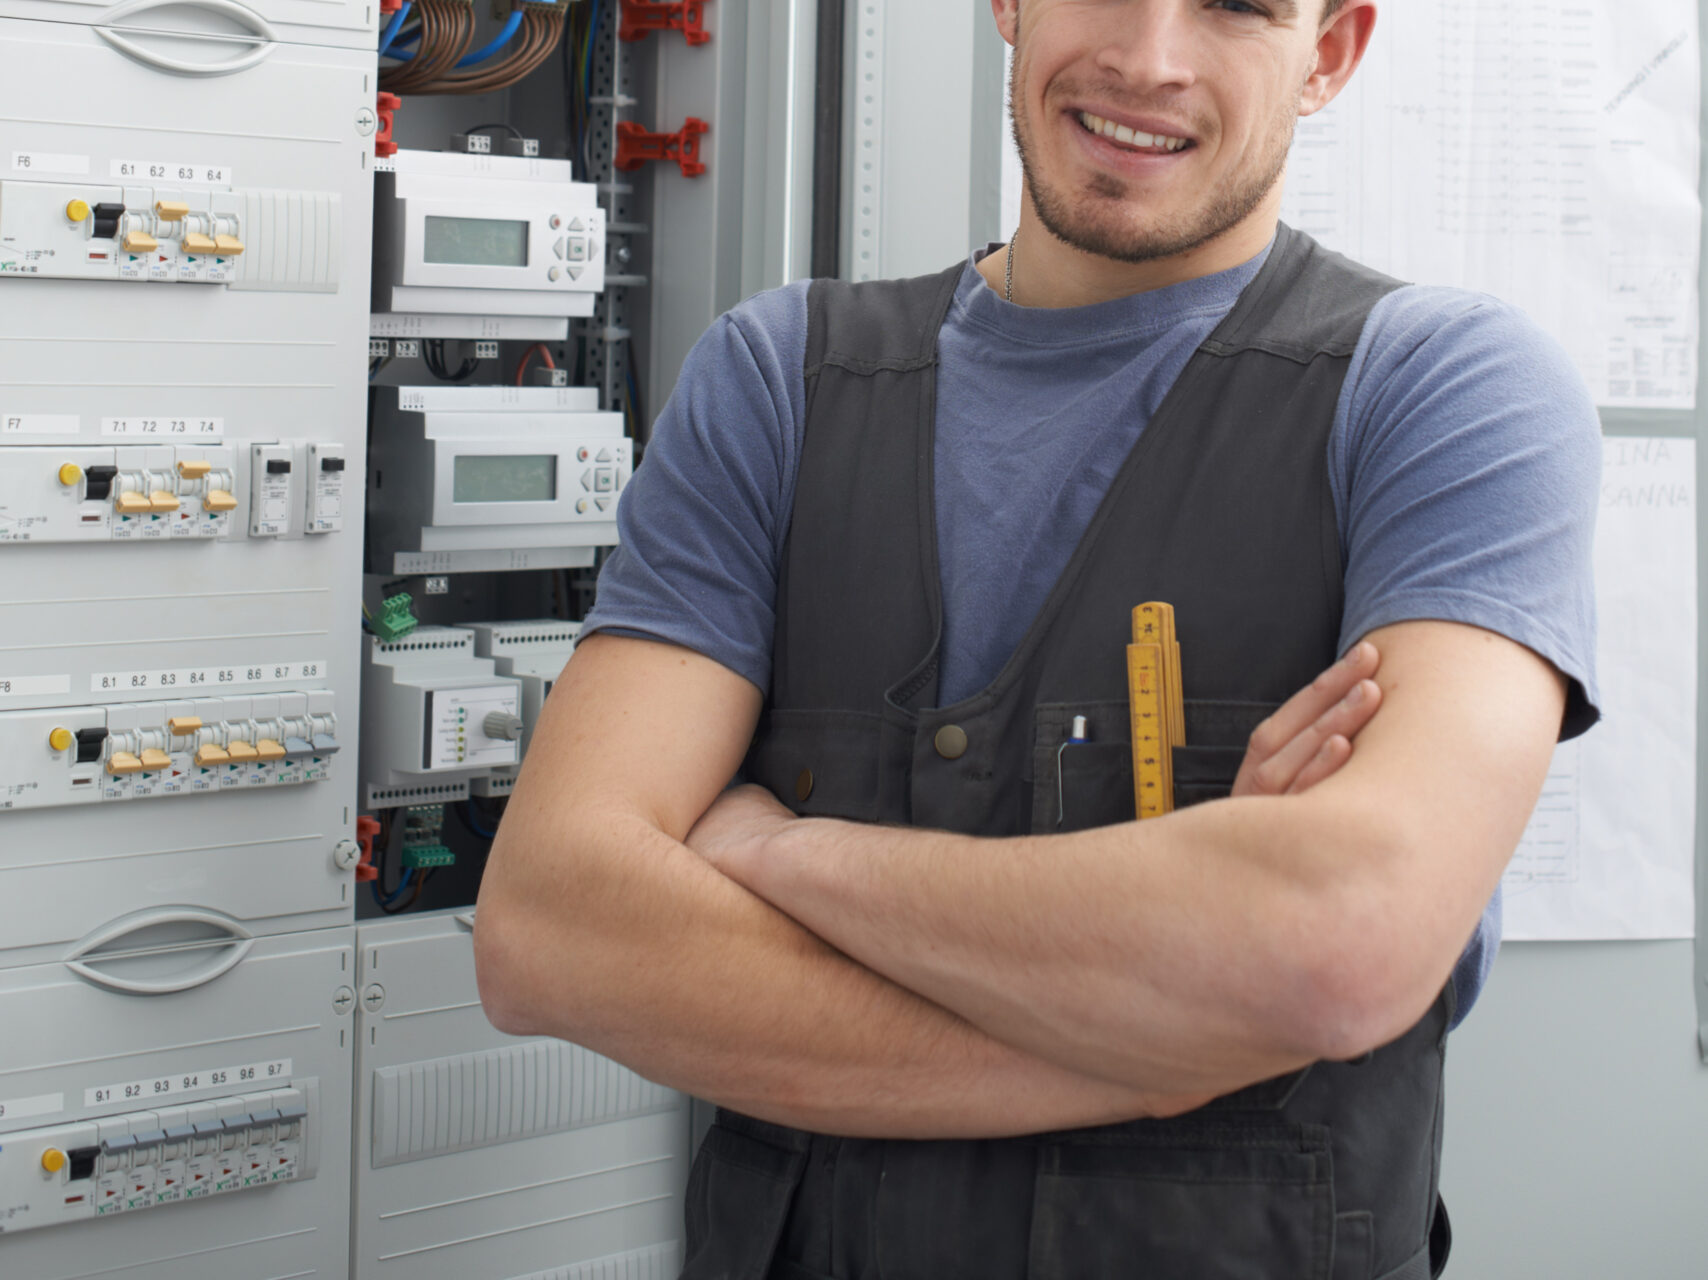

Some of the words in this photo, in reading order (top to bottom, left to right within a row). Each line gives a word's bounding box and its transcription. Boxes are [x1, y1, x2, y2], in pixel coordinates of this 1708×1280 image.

[17, 155, 31, 168] F6
[120, 163, 135, 175] 6.1
[149, 165, 165, 178] 6.2
[178, 167, 193, 180] 6.3
[207, 169, 222, 181] 6.4
[8, 417, 22, 429] F7
[113, 420, 127, 432] 7.1
[142, 420, 157, 433] 7.2
[171, 420, 186, 433] 7.3
[200, 421, 214, 432] 7.4
[102, 676, 116, 689] 8.1
[131, 674, 147, 687] 8.2
[160, 673, 176, 686] 8.3
[190, 672, 205, 684] 8.4
[218, 670, 234, 682] 8.5
[247, 668, 262, 680] 8.6
[274, 666, 290, 679] 8.7
[302, 664, 317, 677] 8.8
[1144, 757, 1155, 765] 5
[95, 1089, 110, 1102] 9.1
[125, 1084, 141, 1098] 9.2
[154, 1080, 170, 1093] 9.3
[183, 1076, 198, 1089] 9.4
[211, 1071, 227, 1085] 9.5
[239, 1067, 255, 1080] 9.6
[267, 1063, 282, 1076] 9.7
